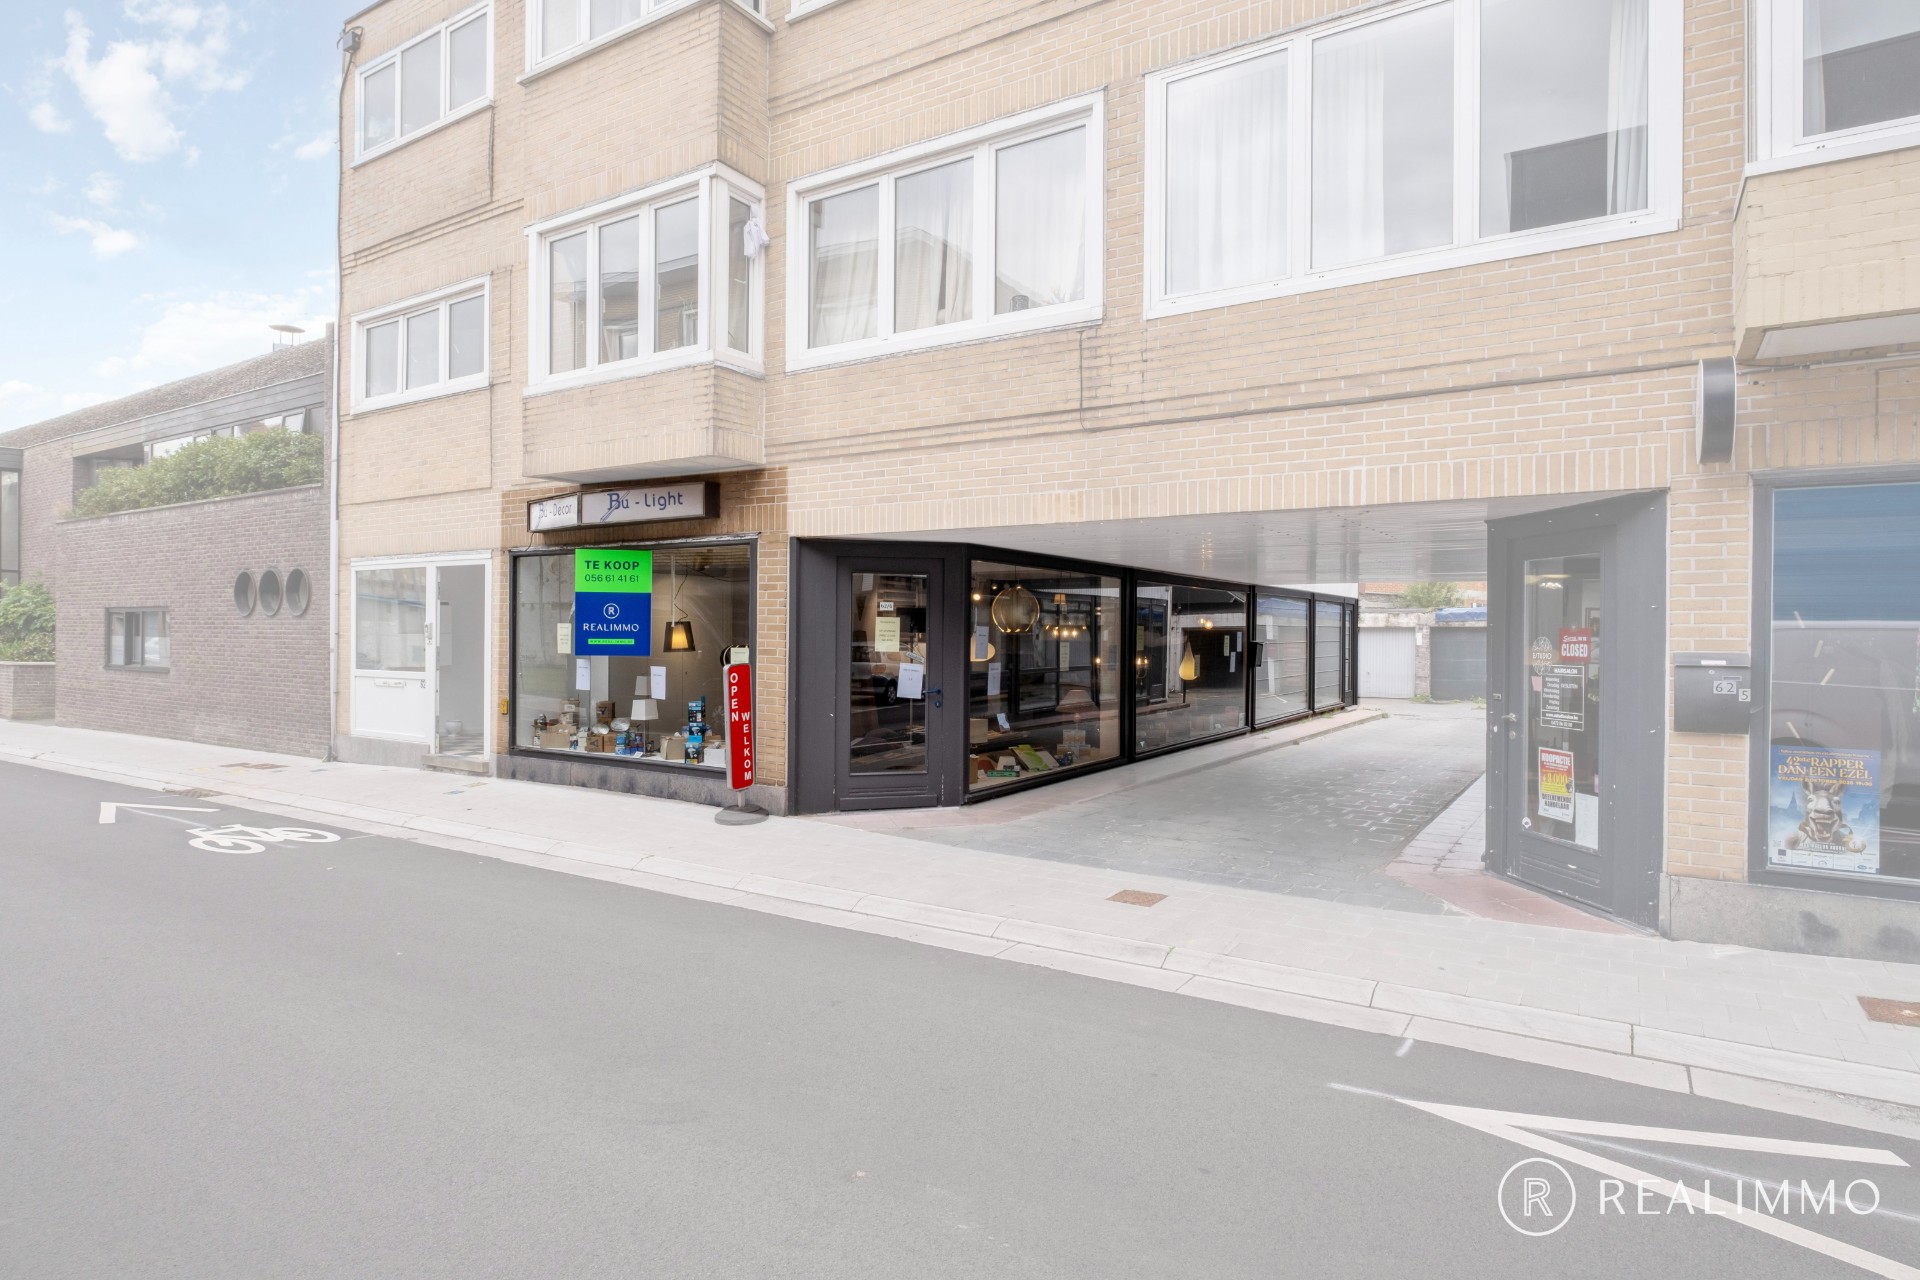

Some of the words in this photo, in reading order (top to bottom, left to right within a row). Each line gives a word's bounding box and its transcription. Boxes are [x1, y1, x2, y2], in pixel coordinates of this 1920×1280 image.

[644, 491, 684, 511] Light
[552, 503, 572, 517] Decor
[584, 560, 600, 570] TE
[604, 560, 640, 571] KOOP
[584, 573, 603, 583] 056
[605, 574, 615, 583] 61
[617, 574, 627, 583] 41
[629, 574, 640, 583] 61
[582, 622, 640, 632] REALIMMO
[1561, 643, 1588, 658] CLOSED
[1553, 667, 1578, 675] HAIRSALON
[1715, 682, 1735, 693] 62
[729, 672, 739, 723] OPEN
[1740, 690, 1749, 701] 5
[741, 711, 752, 781] WELKOM
[1541, 752, 1571, 766] KOOPACTIE
[1810, 757, 1864, 770] RAPPER
[1778, 764, 1806, 776] DAN
[1809, 765, 1837, 778] EEN
[1839, 767, 1873, 780] EZEL
